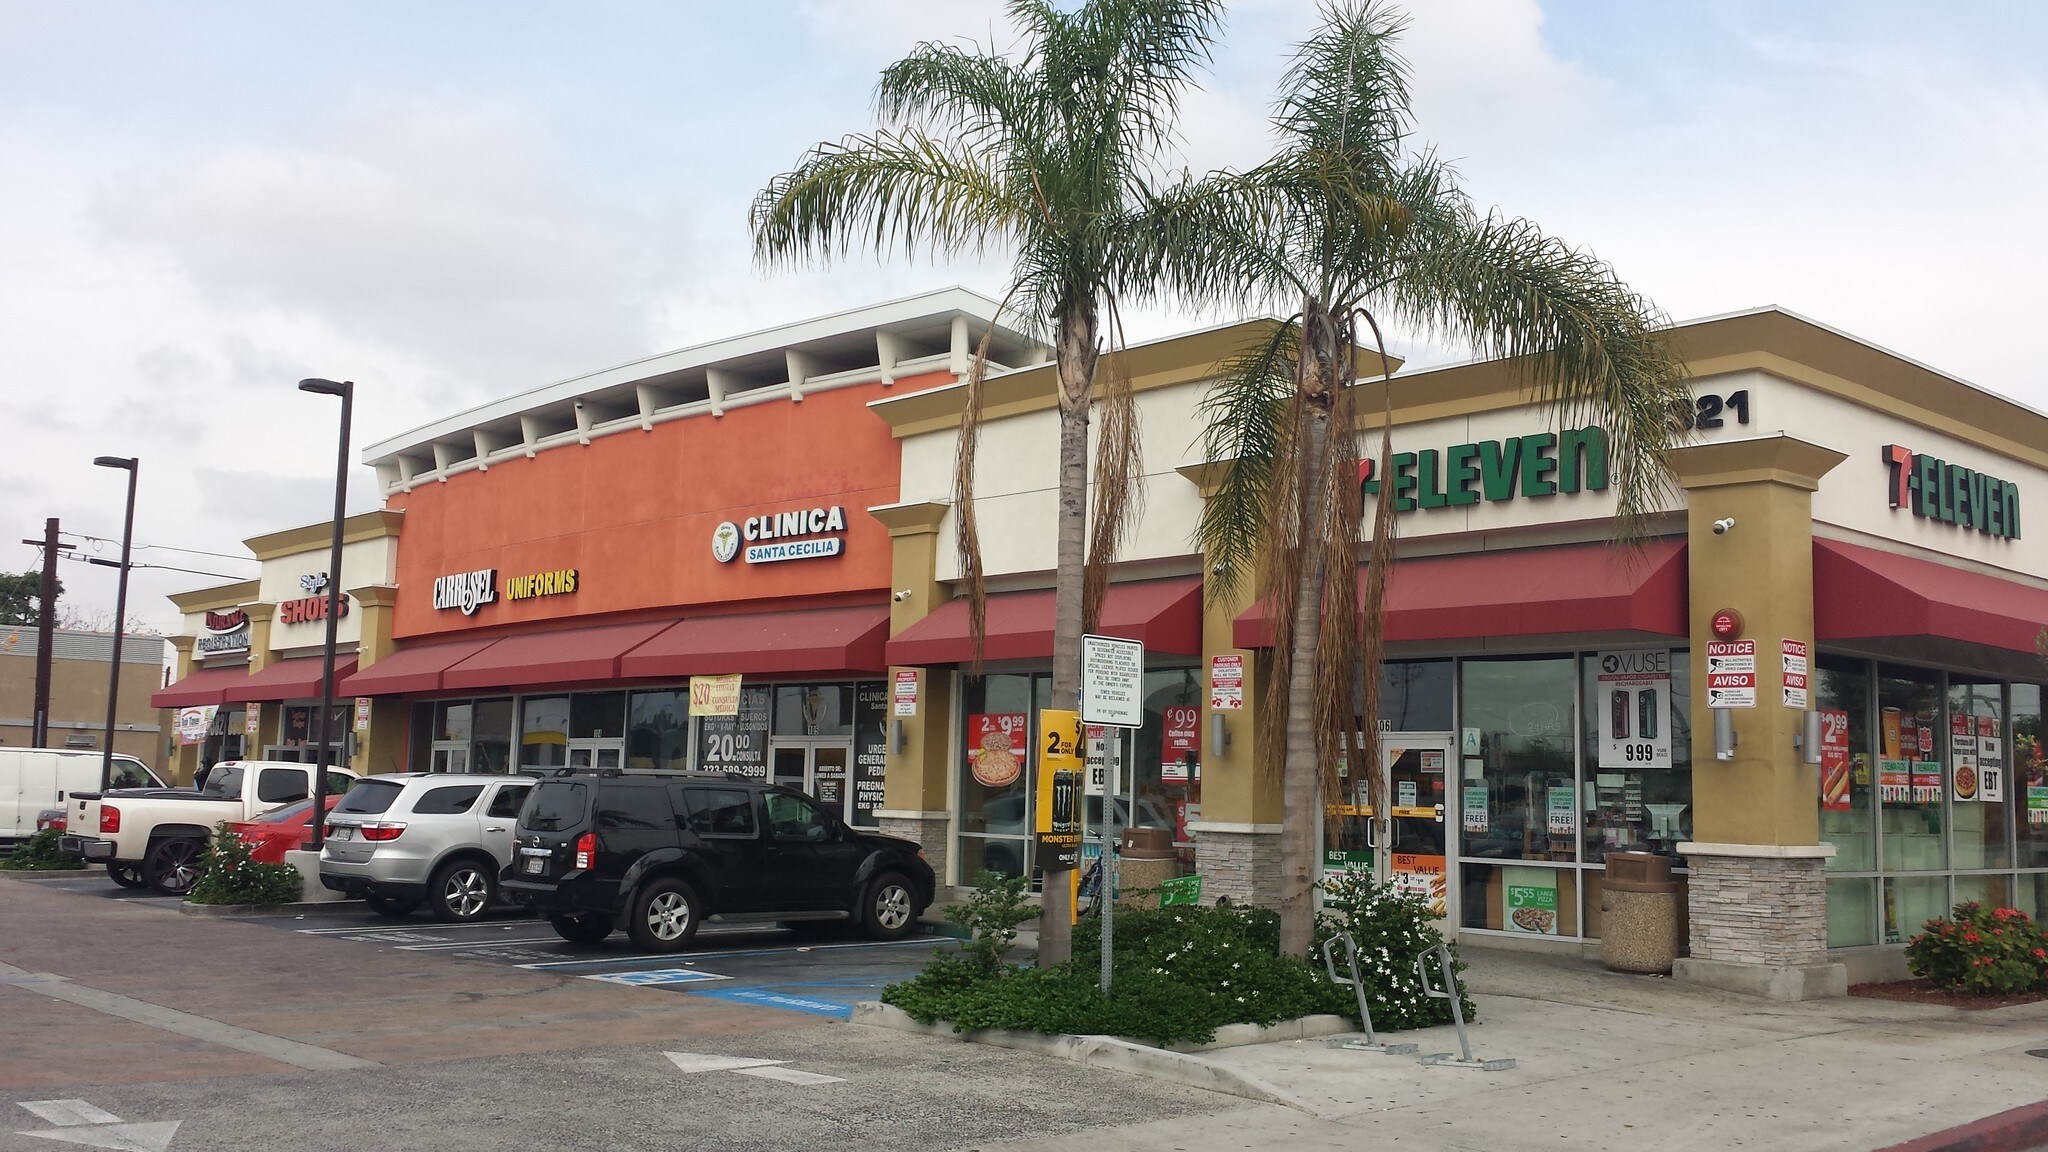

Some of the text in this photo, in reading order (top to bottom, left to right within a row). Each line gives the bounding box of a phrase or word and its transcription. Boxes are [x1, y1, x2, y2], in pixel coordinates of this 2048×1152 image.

[1683, 390, 1749, 430] 21
[744, 506, 844, 541] CLINICA
[750, 540, 833, 560] SANTA CECILIA
[300, 572, 328, 594] Style
[433, 569, 575, 615] CARRUSEL UNIFORMS
[198, 633, 248, 651] REGISTRATION
[1709, 643, 1752, 654] NOTICE
[1784, 642, 1805, 655] NOTICE
[1619, 653, 1665, 672] VUSE
[1713, 676, 1748, 686] AVISO
[1786, 675, 1804, 686] AVISO
[694, 683, 710, 706] $20
[860, 692, 888, 701] CLINICA
[741, 712, 767, 721] SUEROS
[982, 717, 989, 731] 2
[1048, 732, 1060, 753] 2
[1466, 733, 1476, 746] A
[737, 751, 761, 761] CONSULTA
[1626, 744, 1652, 761] 9.99
[1984, 771, 1997, 790] EBT
[1550, 816, 1573, 824] FREE!
[1042, 835, 1073, 843] MONSTER
[1329, 851, 1347, 860] BEST
[1398, 856, 1416, 864] BEST
[1344, 861, 1368, 870] VALUE
[1414, 866, 1439, 875] VALUE
